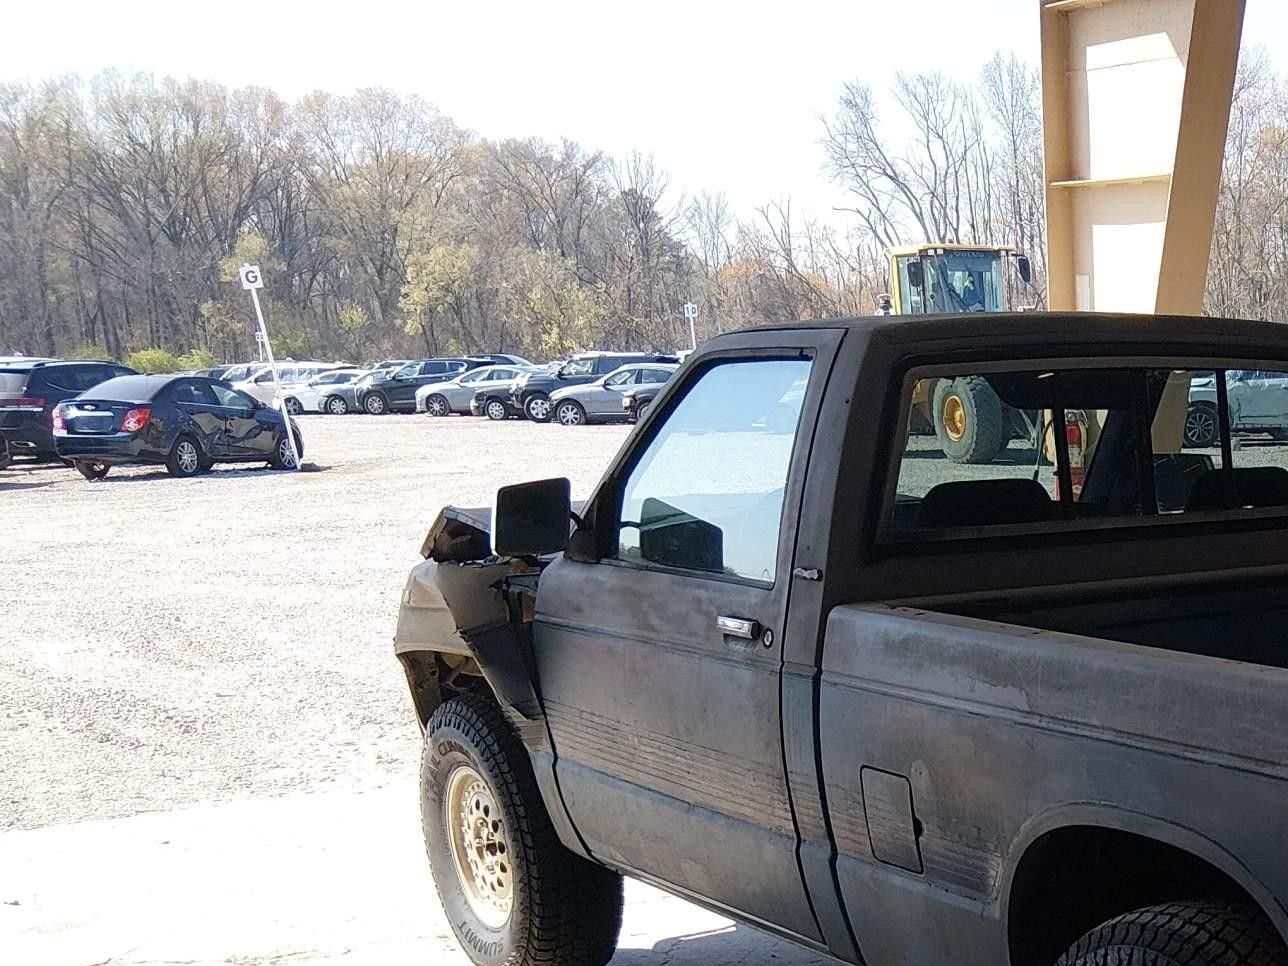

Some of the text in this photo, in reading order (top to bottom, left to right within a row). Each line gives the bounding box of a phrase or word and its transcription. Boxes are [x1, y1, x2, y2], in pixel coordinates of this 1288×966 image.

[245, 270, 258, 283] G
[686, 306, 697, 315] 10
[457, 920, 504, 956] SUMMIT
